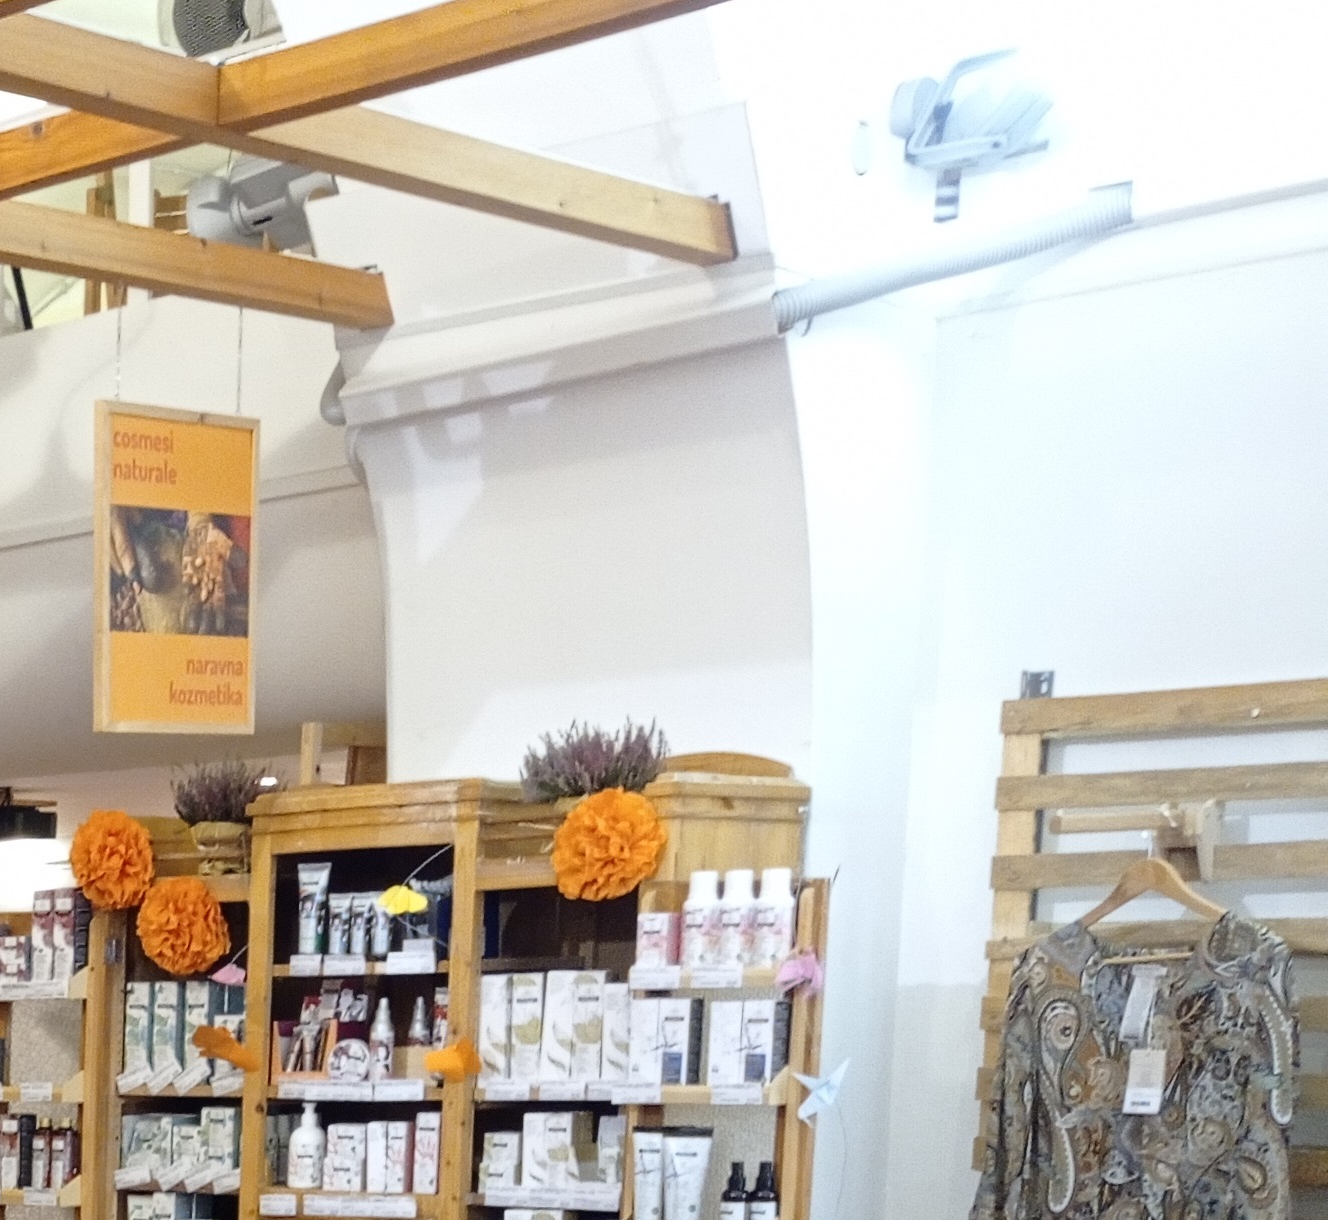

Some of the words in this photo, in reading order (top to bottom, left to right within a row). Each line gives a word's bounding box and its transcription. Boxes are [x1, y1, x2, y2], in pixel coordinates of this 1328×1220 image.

[113, 428, 174, 455] cosmesi
[112, 459, 178, 485] naturale
[186, 656, 244, 678] naravna
[169, 680, 244, 706] kozmetika
